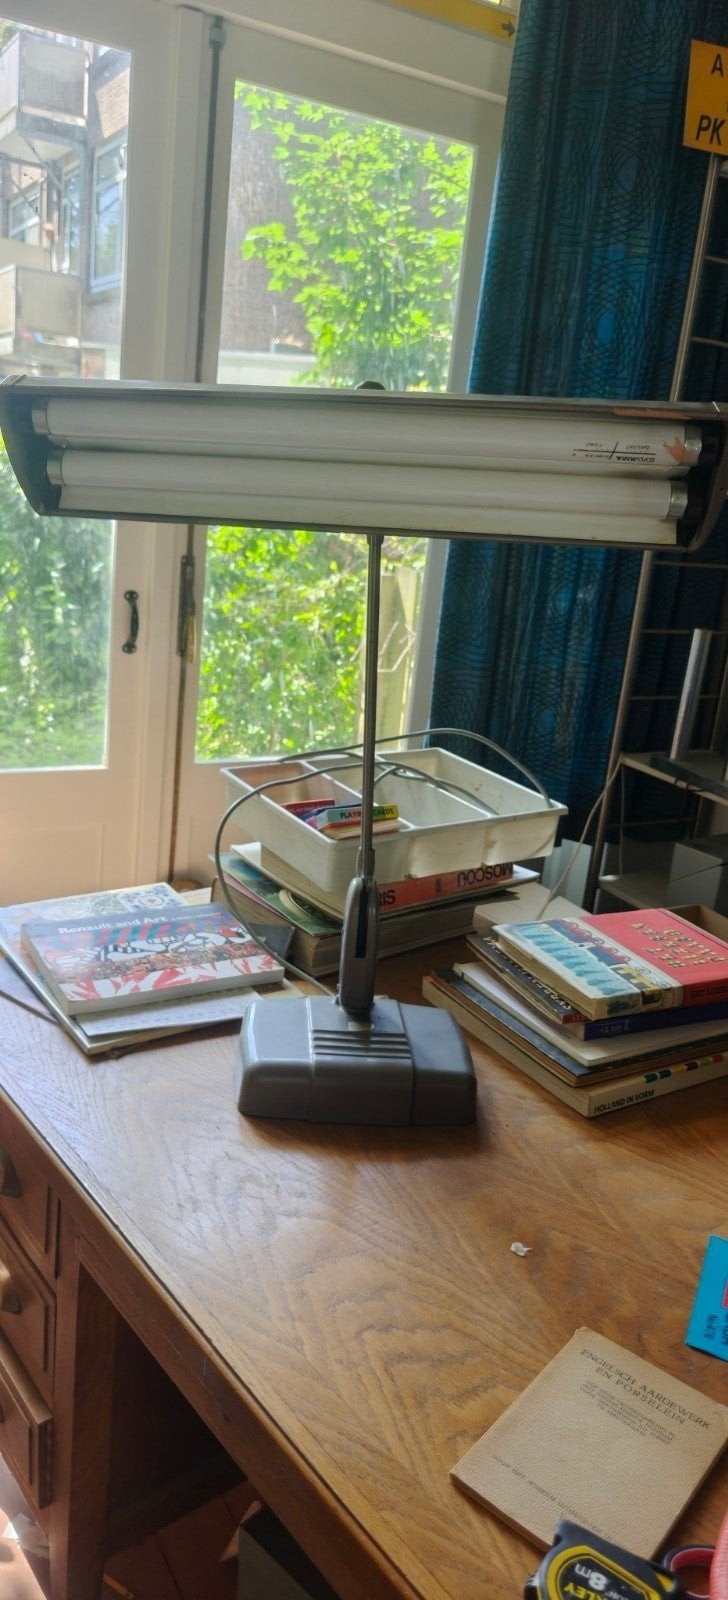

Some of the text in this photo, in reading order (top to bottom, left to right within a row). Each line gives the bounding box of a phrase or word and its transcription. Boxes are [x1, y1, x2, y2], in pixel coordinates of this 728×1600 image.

[711, 53, 724, 77] A
[695, 115, 727, 146] PK
[457, 862, 513, 887] MOSCOU
[58, 923, 112, 934] Renault
[116, 918, 140, 928] and
[143, 915, 168, 924] Art
[593, 1089, 655, 1113] HOLLAND IN VORM
[580, 1349, 636, 1385] ENGELSCH
[639, 1384, 712, 1430] AARDEWERK
[595, 1367, 612, 1380] EN
[615, 1379, 686, 1424] PORSELEIN
